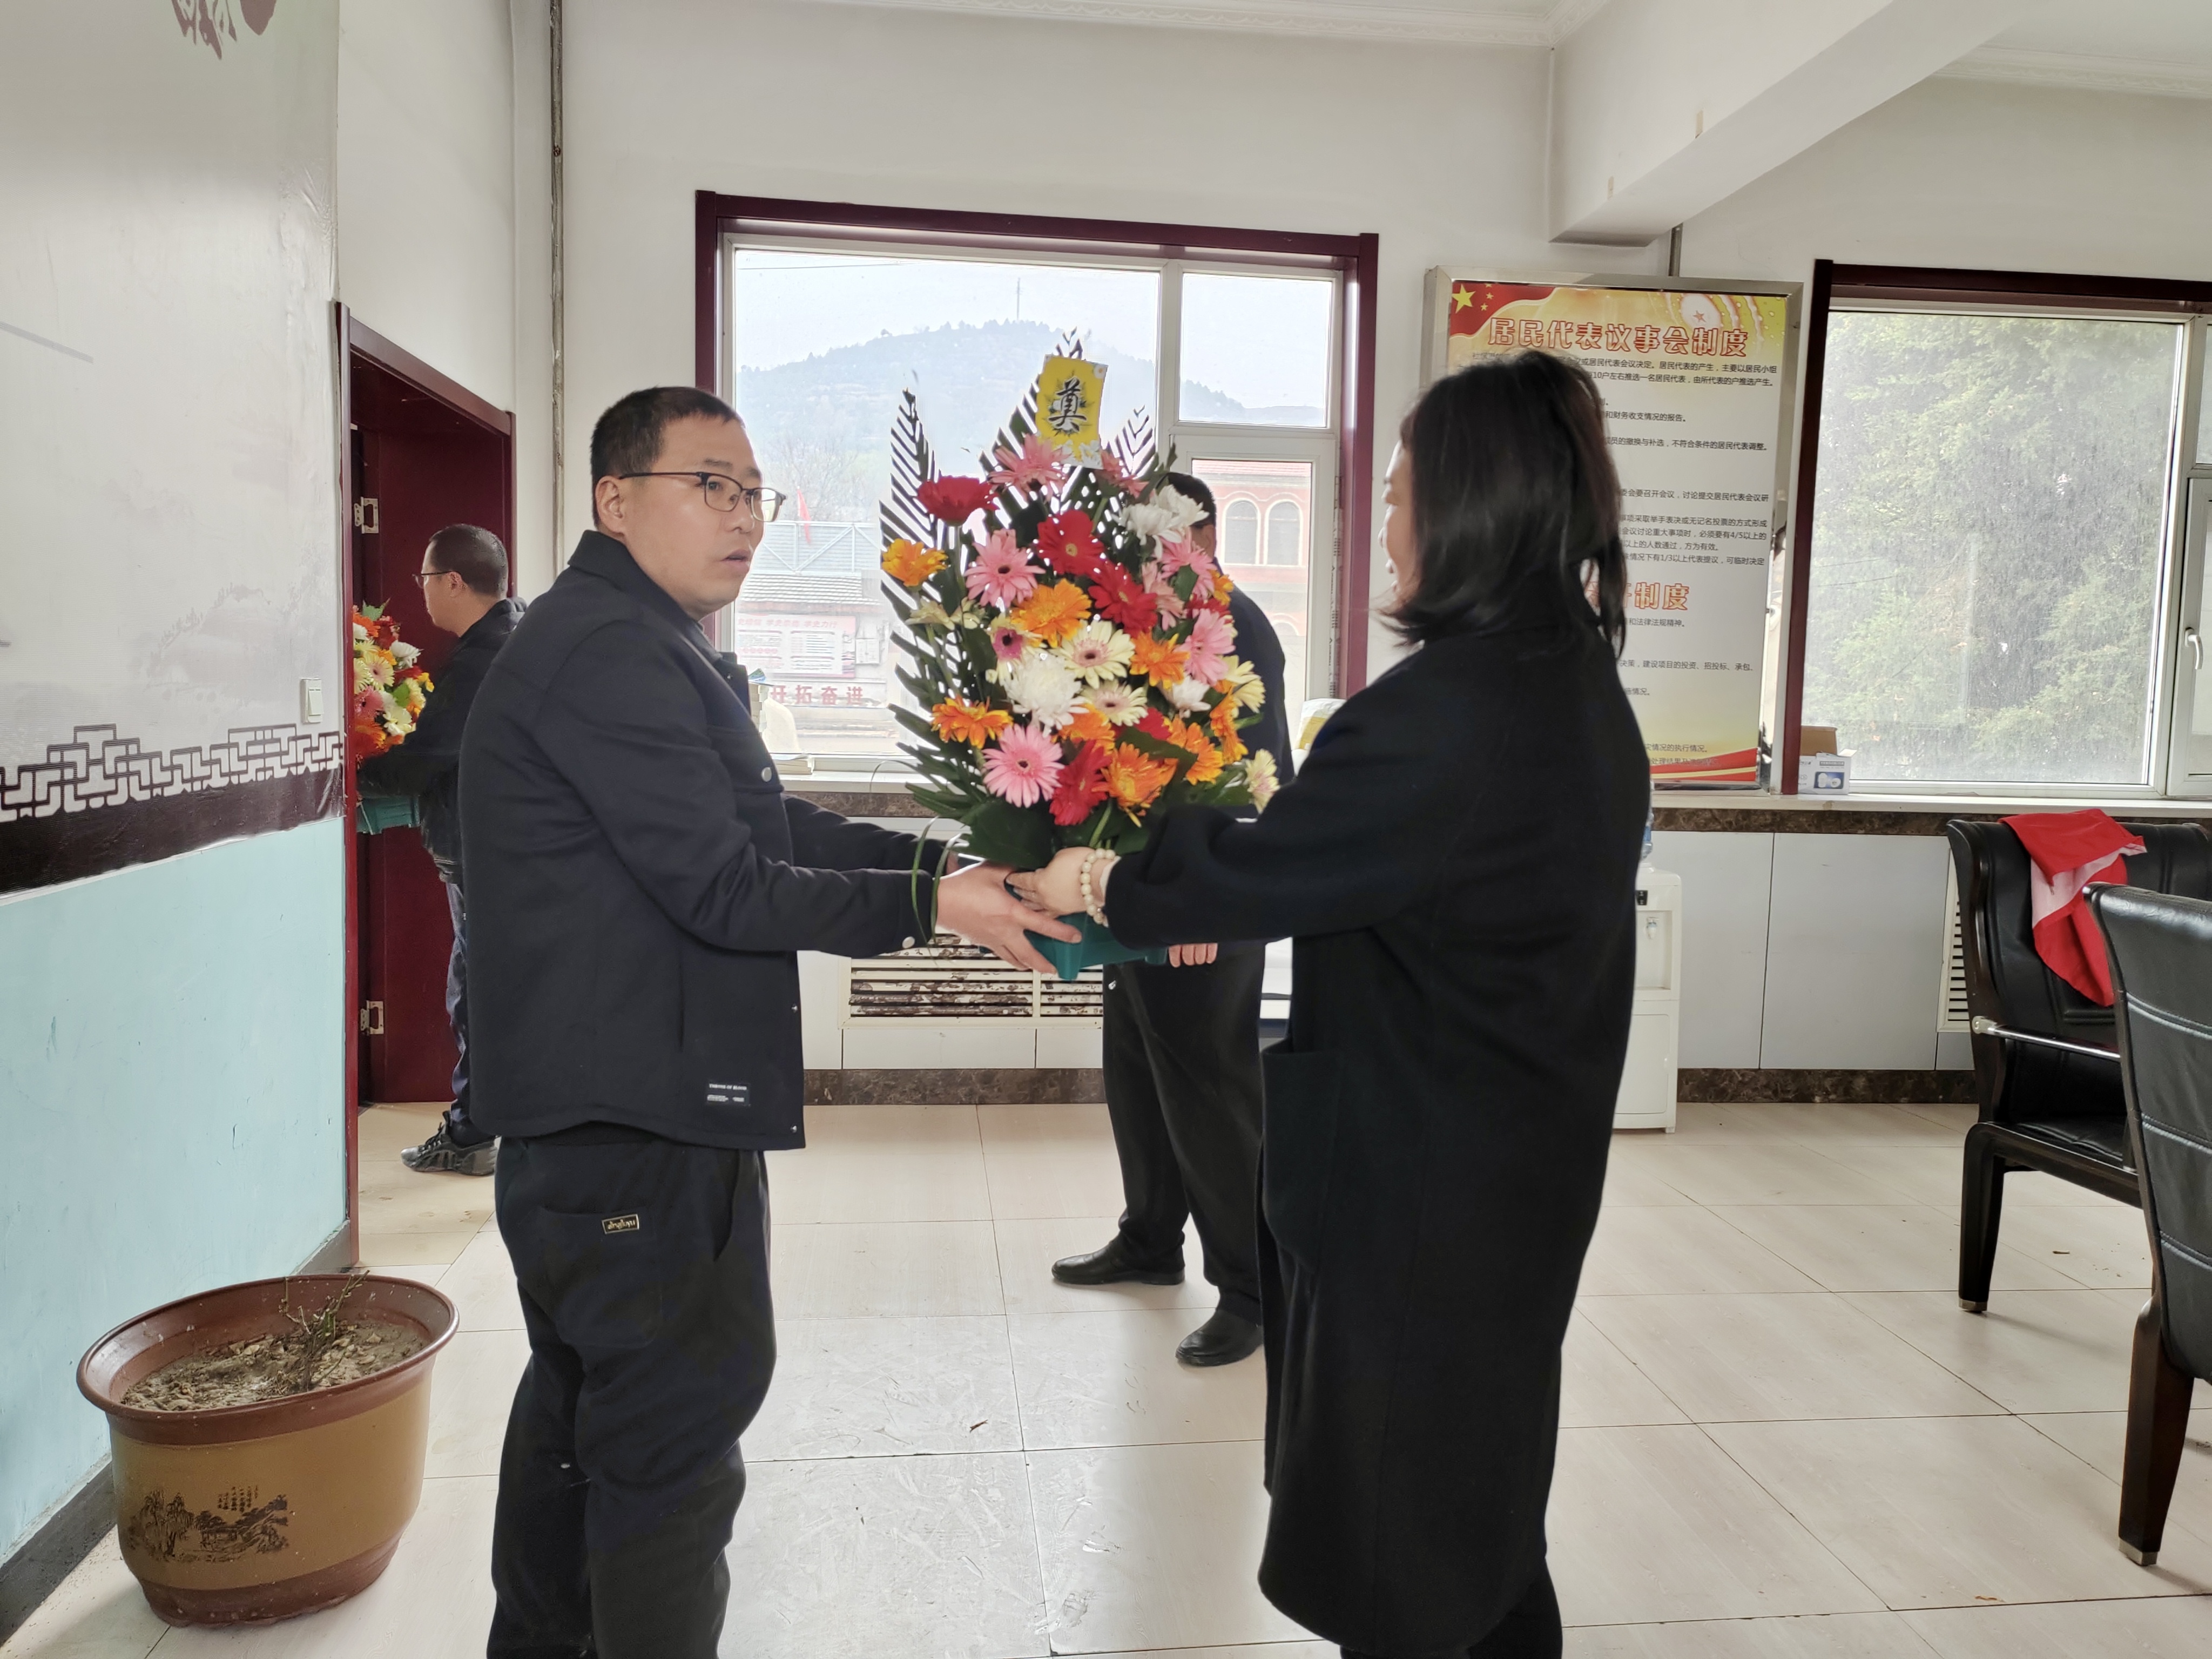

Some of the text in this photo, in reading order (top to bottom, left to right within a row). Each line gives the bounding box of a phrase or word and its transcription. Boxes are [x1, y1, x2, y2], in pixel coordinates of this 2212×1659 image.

[1488, 318, 1748, 357] 居民代表议事会制度
